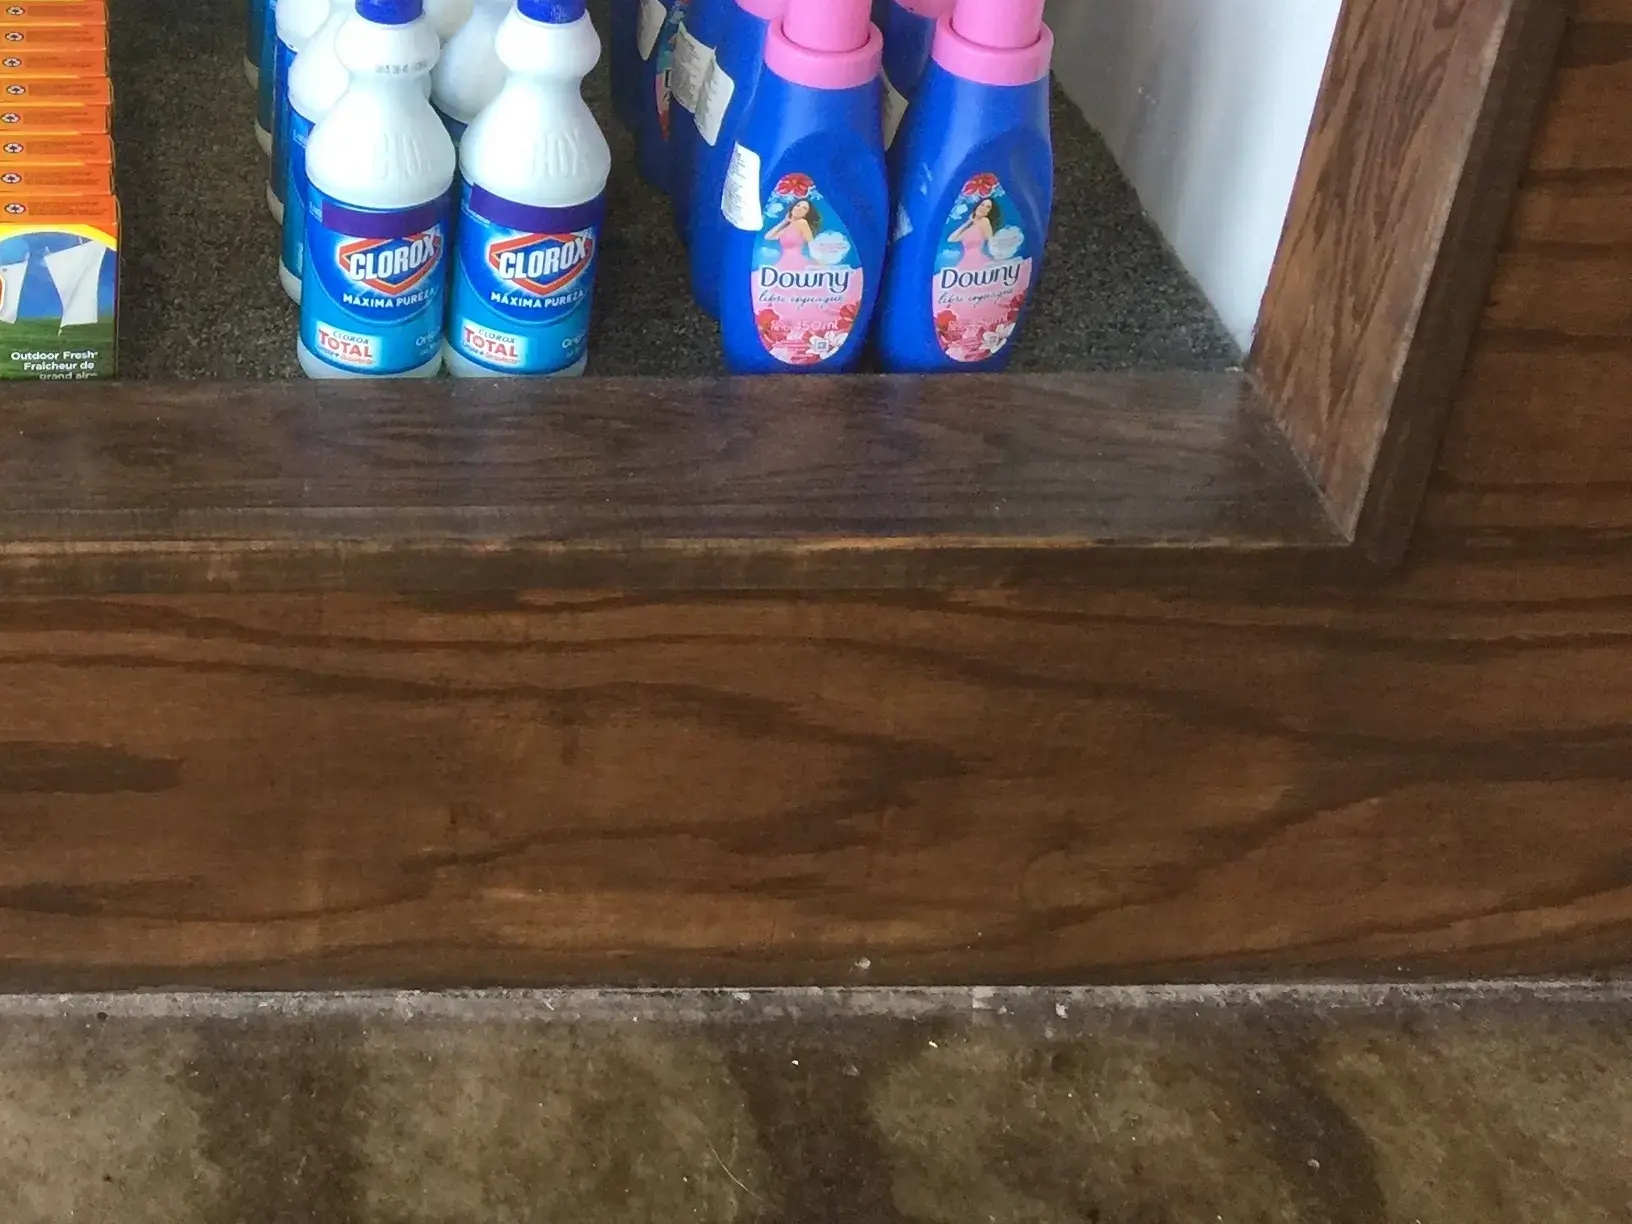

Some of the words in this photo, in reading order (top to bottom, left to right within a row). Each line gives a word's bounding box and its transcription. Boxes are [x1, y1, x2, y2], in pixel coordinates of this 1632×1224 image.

[349, 233, 436, 281] CLOROX
[498, 232, 587, 280] CLOROX
[760, 267, 850, 294] Downy
[941, 264, 1020, 289] Downy
[396, 288, 436, 306] PUREZA
[544, 290, 584, 308] PUREZA
[318, 330, 372, 358] TOTAL
[333, 330, 369, 345] CLOROX
[464, 327, 518, 358] TOTAL
[478, 328, 516, 344] CLOROX
[11, 352, 59, 361] Outdoor
[63, 350, 96, 360] Fresh
[80, 362, 94, 370] de
